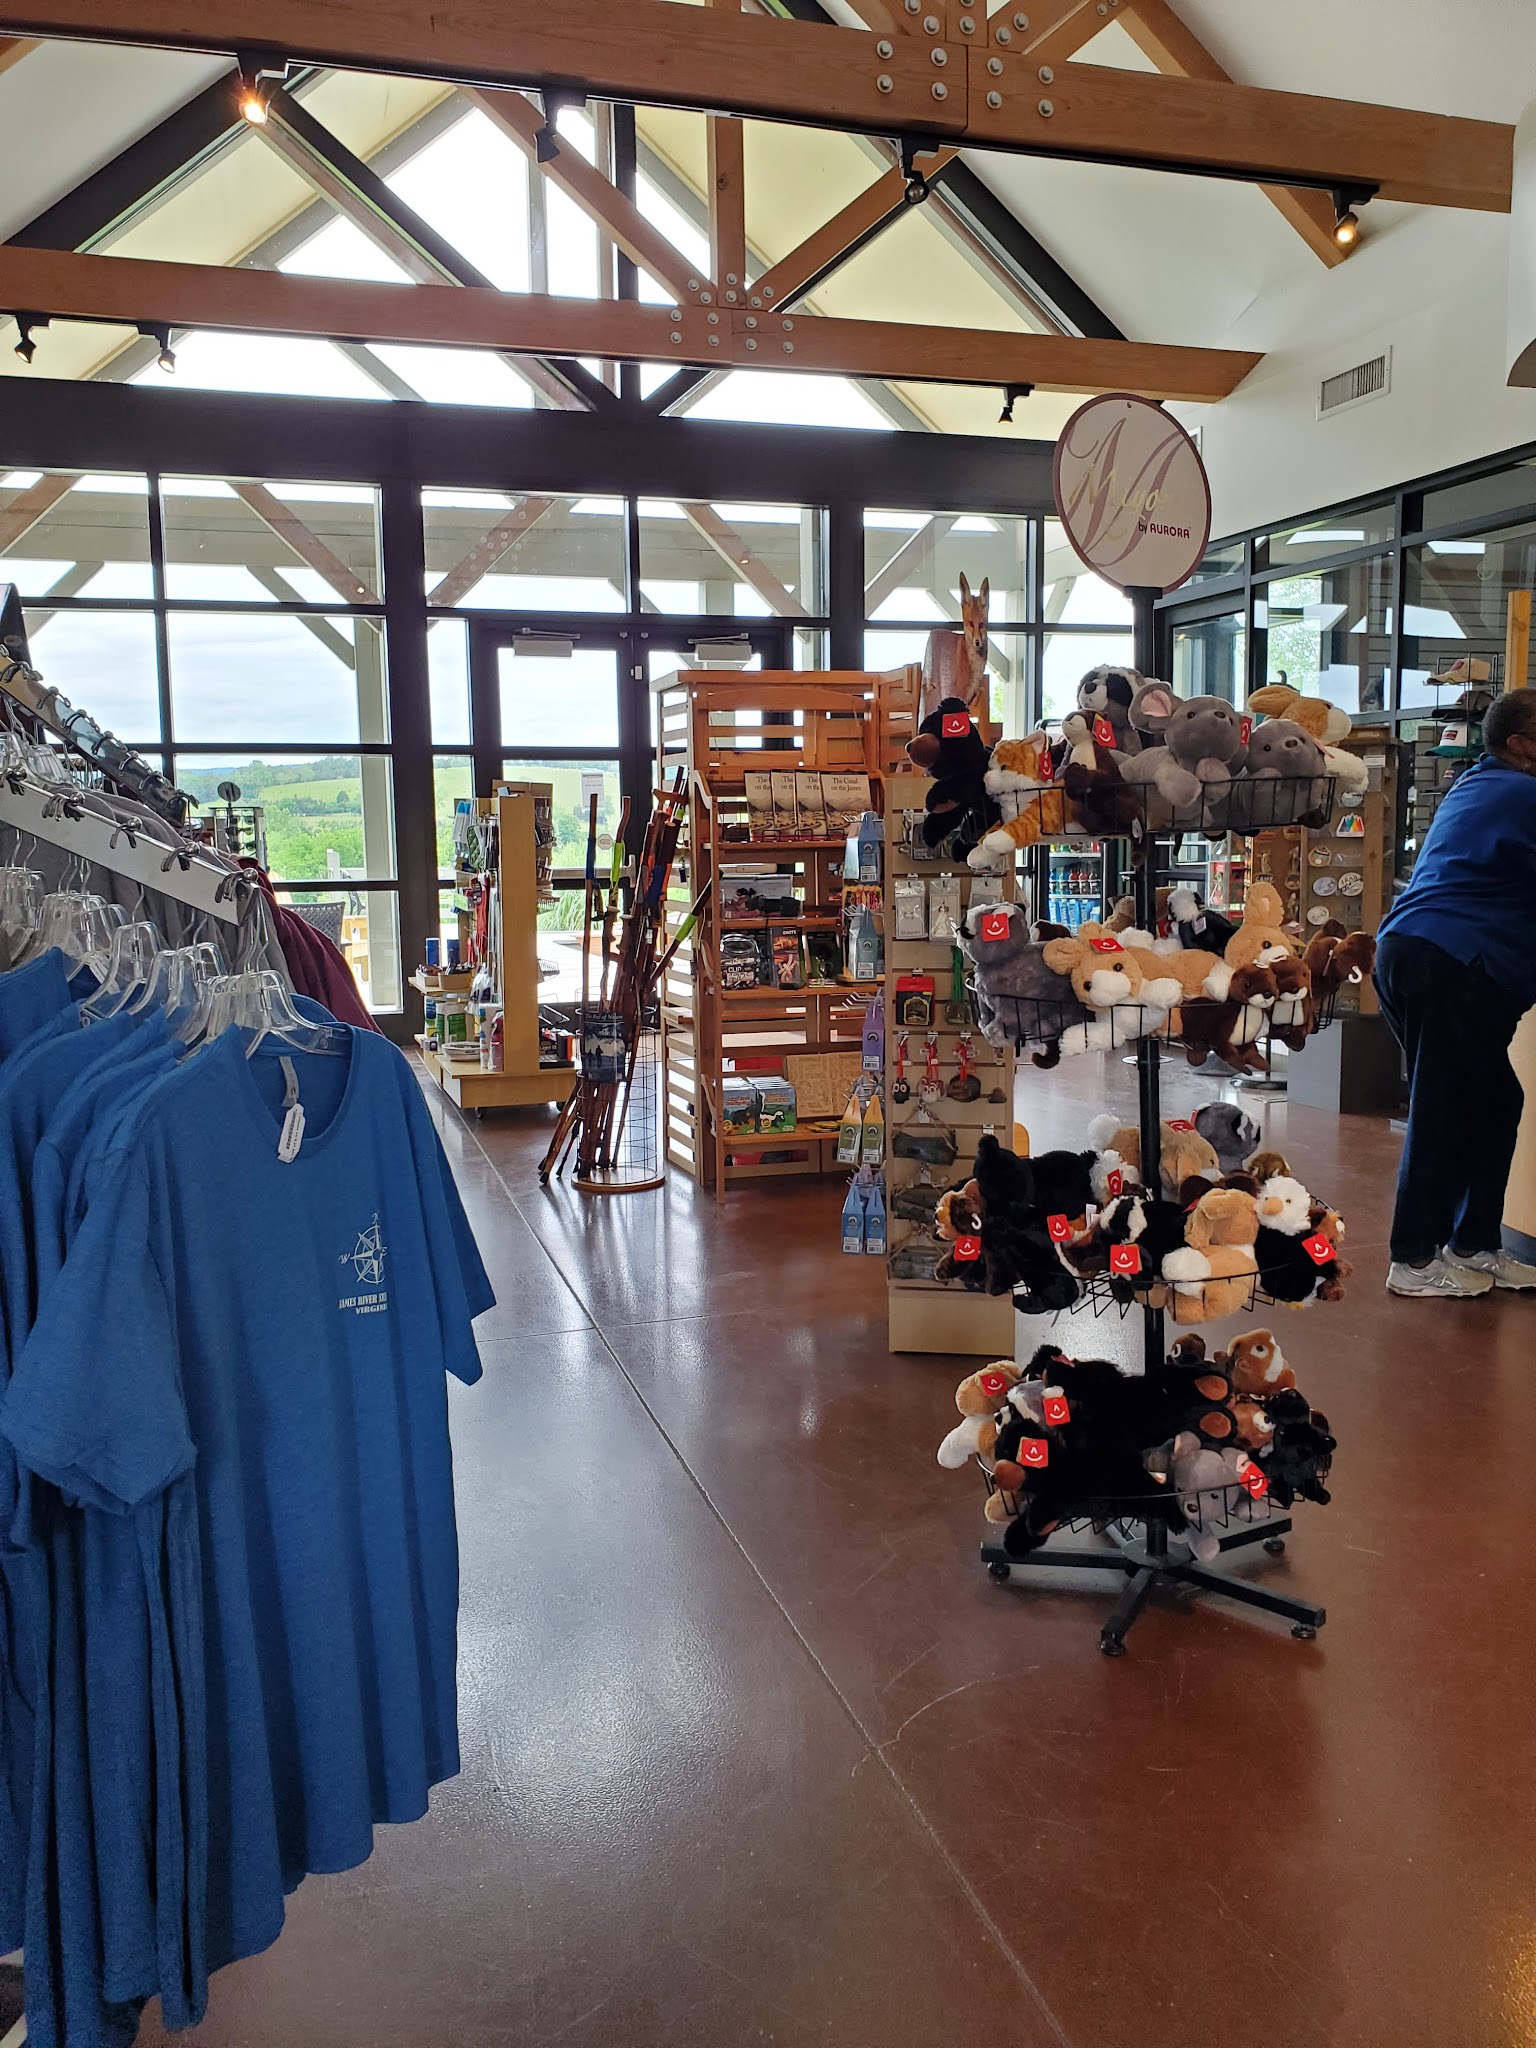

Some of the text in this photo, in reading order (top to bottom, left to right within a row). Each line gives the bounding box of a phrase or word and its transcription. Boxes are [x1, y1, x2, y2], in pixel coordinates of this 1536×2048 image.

[1138, 520, 1190, 540] by AURORA
[843, 777, 859, 785] Canal
[339, 1297, 356, 1309] JAMES
[358, 1294, 377, 1305] RIVER
